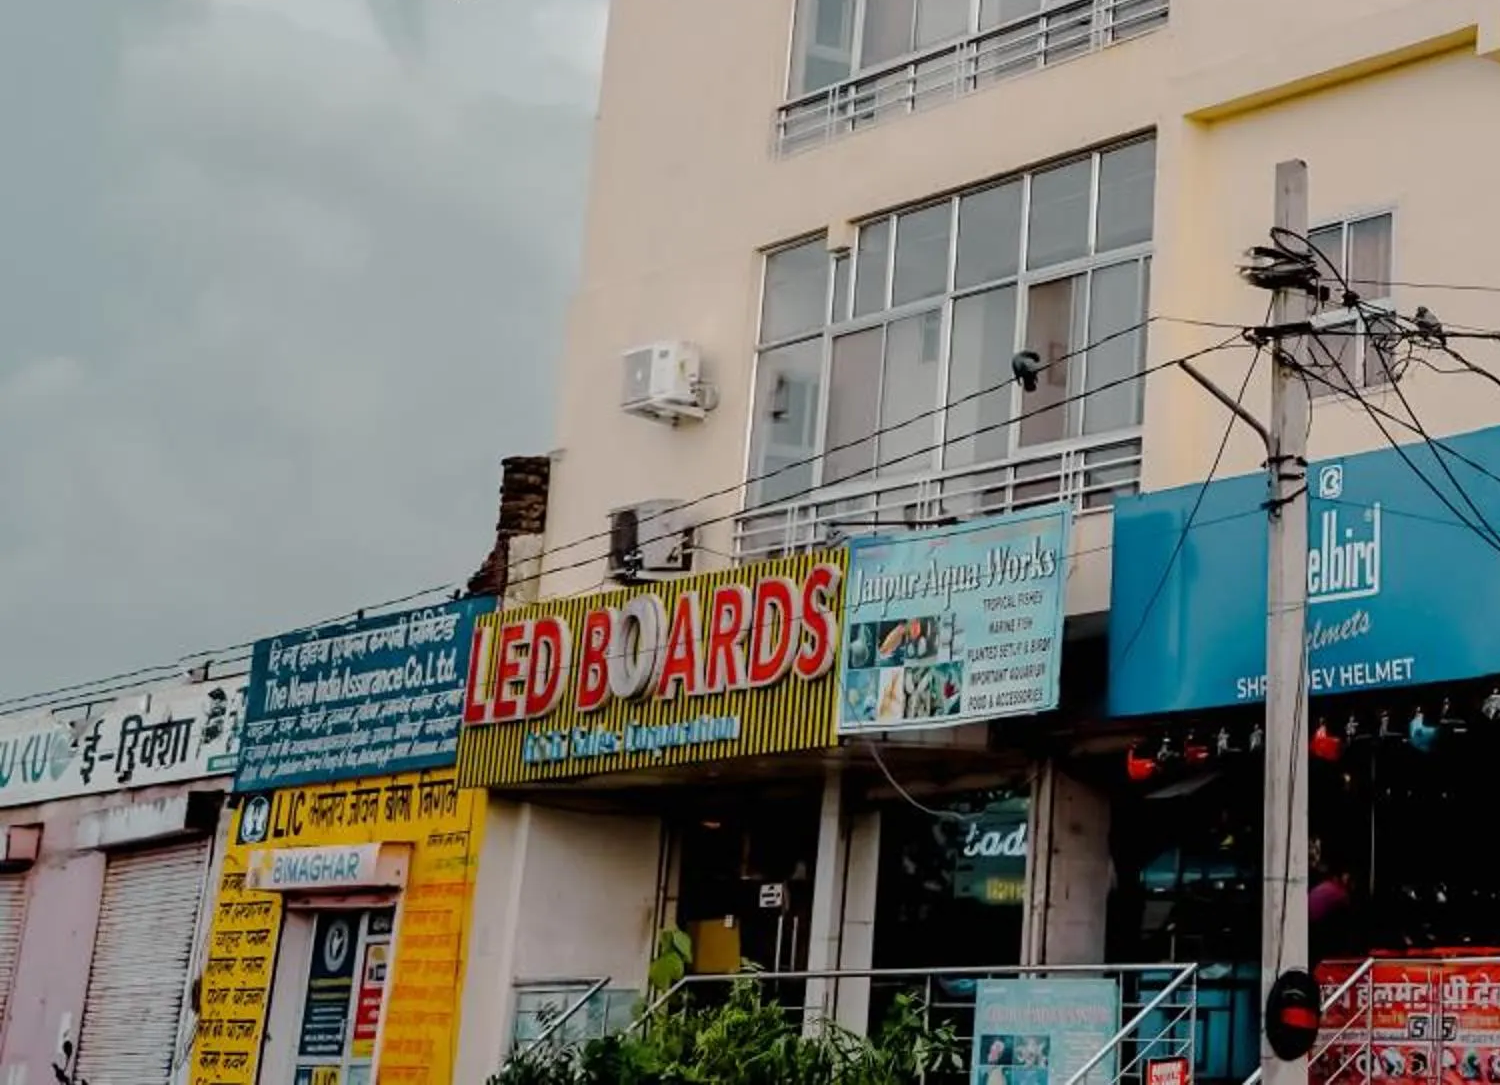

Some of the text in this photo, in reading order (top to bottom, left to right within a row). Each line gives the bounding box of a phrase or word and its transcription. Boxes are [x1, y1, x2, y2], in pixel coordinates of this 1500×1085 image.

[1308, 501, 1381, 603] elbird
[852, 535, 1057, 617] Jaipur Aqua Works
[983, 595, 1016, 613] TROPICAL
[463, 616, 573, 726] LED
[575, 563, 842, 712] BOARDS
[1305, 609, 1372, 651] elmets
[264, 678, 287, 712] The
[288, 672, 315, 709] New
[315, 670, 342, 703] India
[342, 665, 403, 698] Assurance
[1339, 658, 1415, 685] HELMET
[272, 790, 305, 838] LIC
[348, 776, 381, 826] जीवन
[384, 773, 414, 823] बीमा
[272, 851, 361, 884] BIMAGHAR
